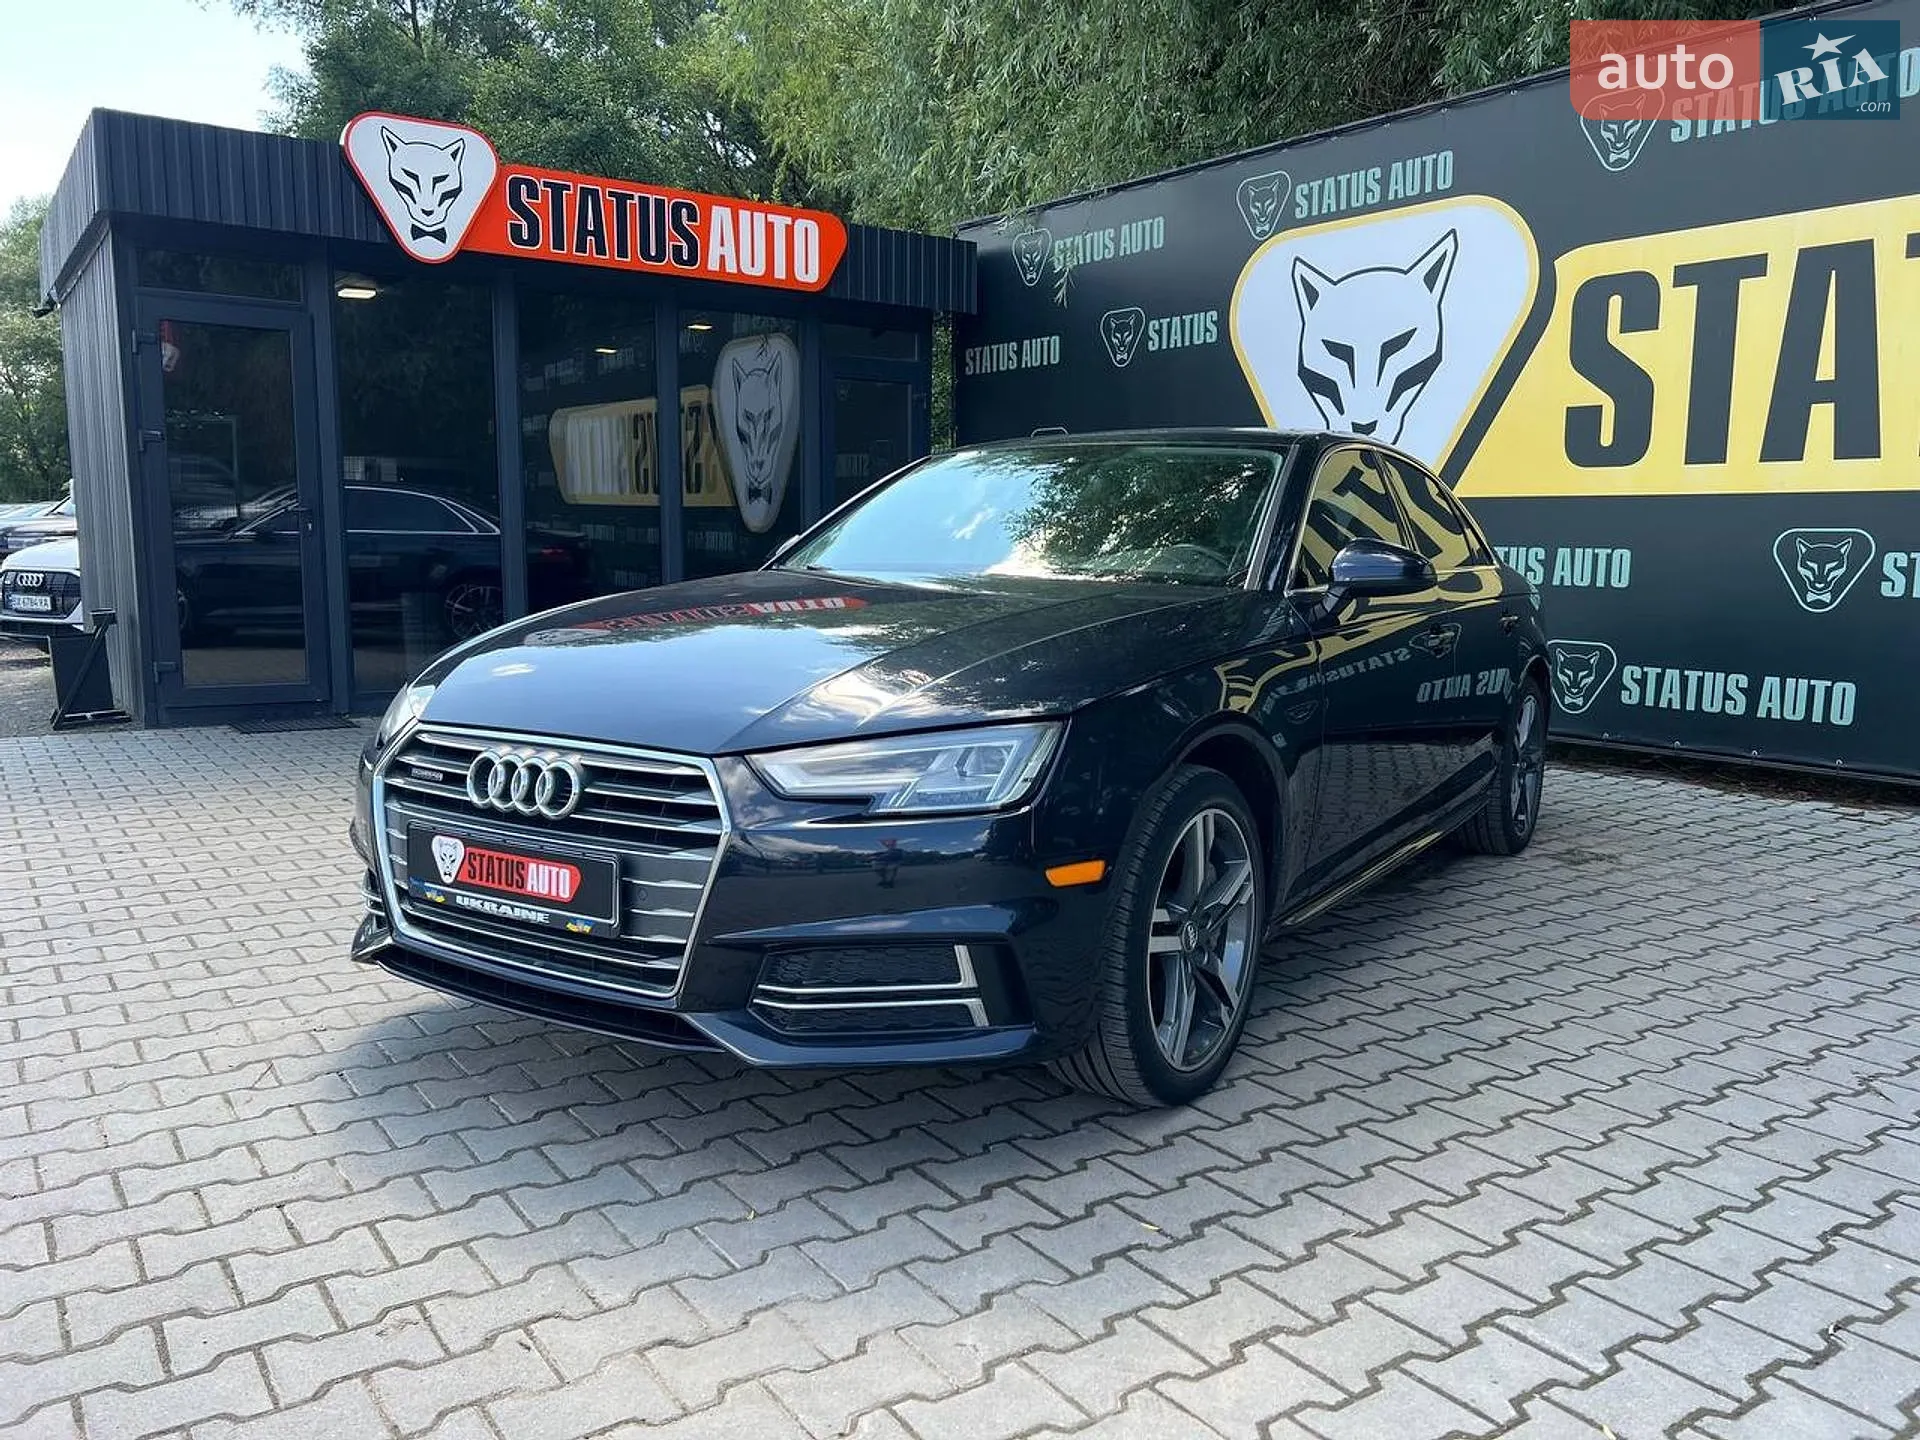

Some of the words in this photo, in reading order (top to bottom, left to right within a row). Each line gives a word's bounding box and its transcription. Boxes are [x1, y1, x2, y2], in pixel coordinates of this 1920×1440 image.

[1294, 166, 1381, 219] STATUS
[1387, 150, 1454, 198] AUTO
[506, 174, 701, 270] STATUS
[707, 205, 820, 283] AUTO
[1052, 230, 1115, 272] STATUS
[1119, 215, 1165, 256] AUTO
[965, 341, 1018, 376] STATUS
[1021, 335, 1060, 369] AUTO
[1147, 310, 1218, 352] STATUS
[1565, 232, 1920, 468] STA
[1552, 547, 1632, 588] AUTO
[1621, 665, 1747, 716] STATUS
[1757, 675, 1856, 727] AUTO
[467, 850, 526, 891] STATUS
[526, 863, 571, 899] AUTO
[455, 894, 551, 924] UKRAINE
